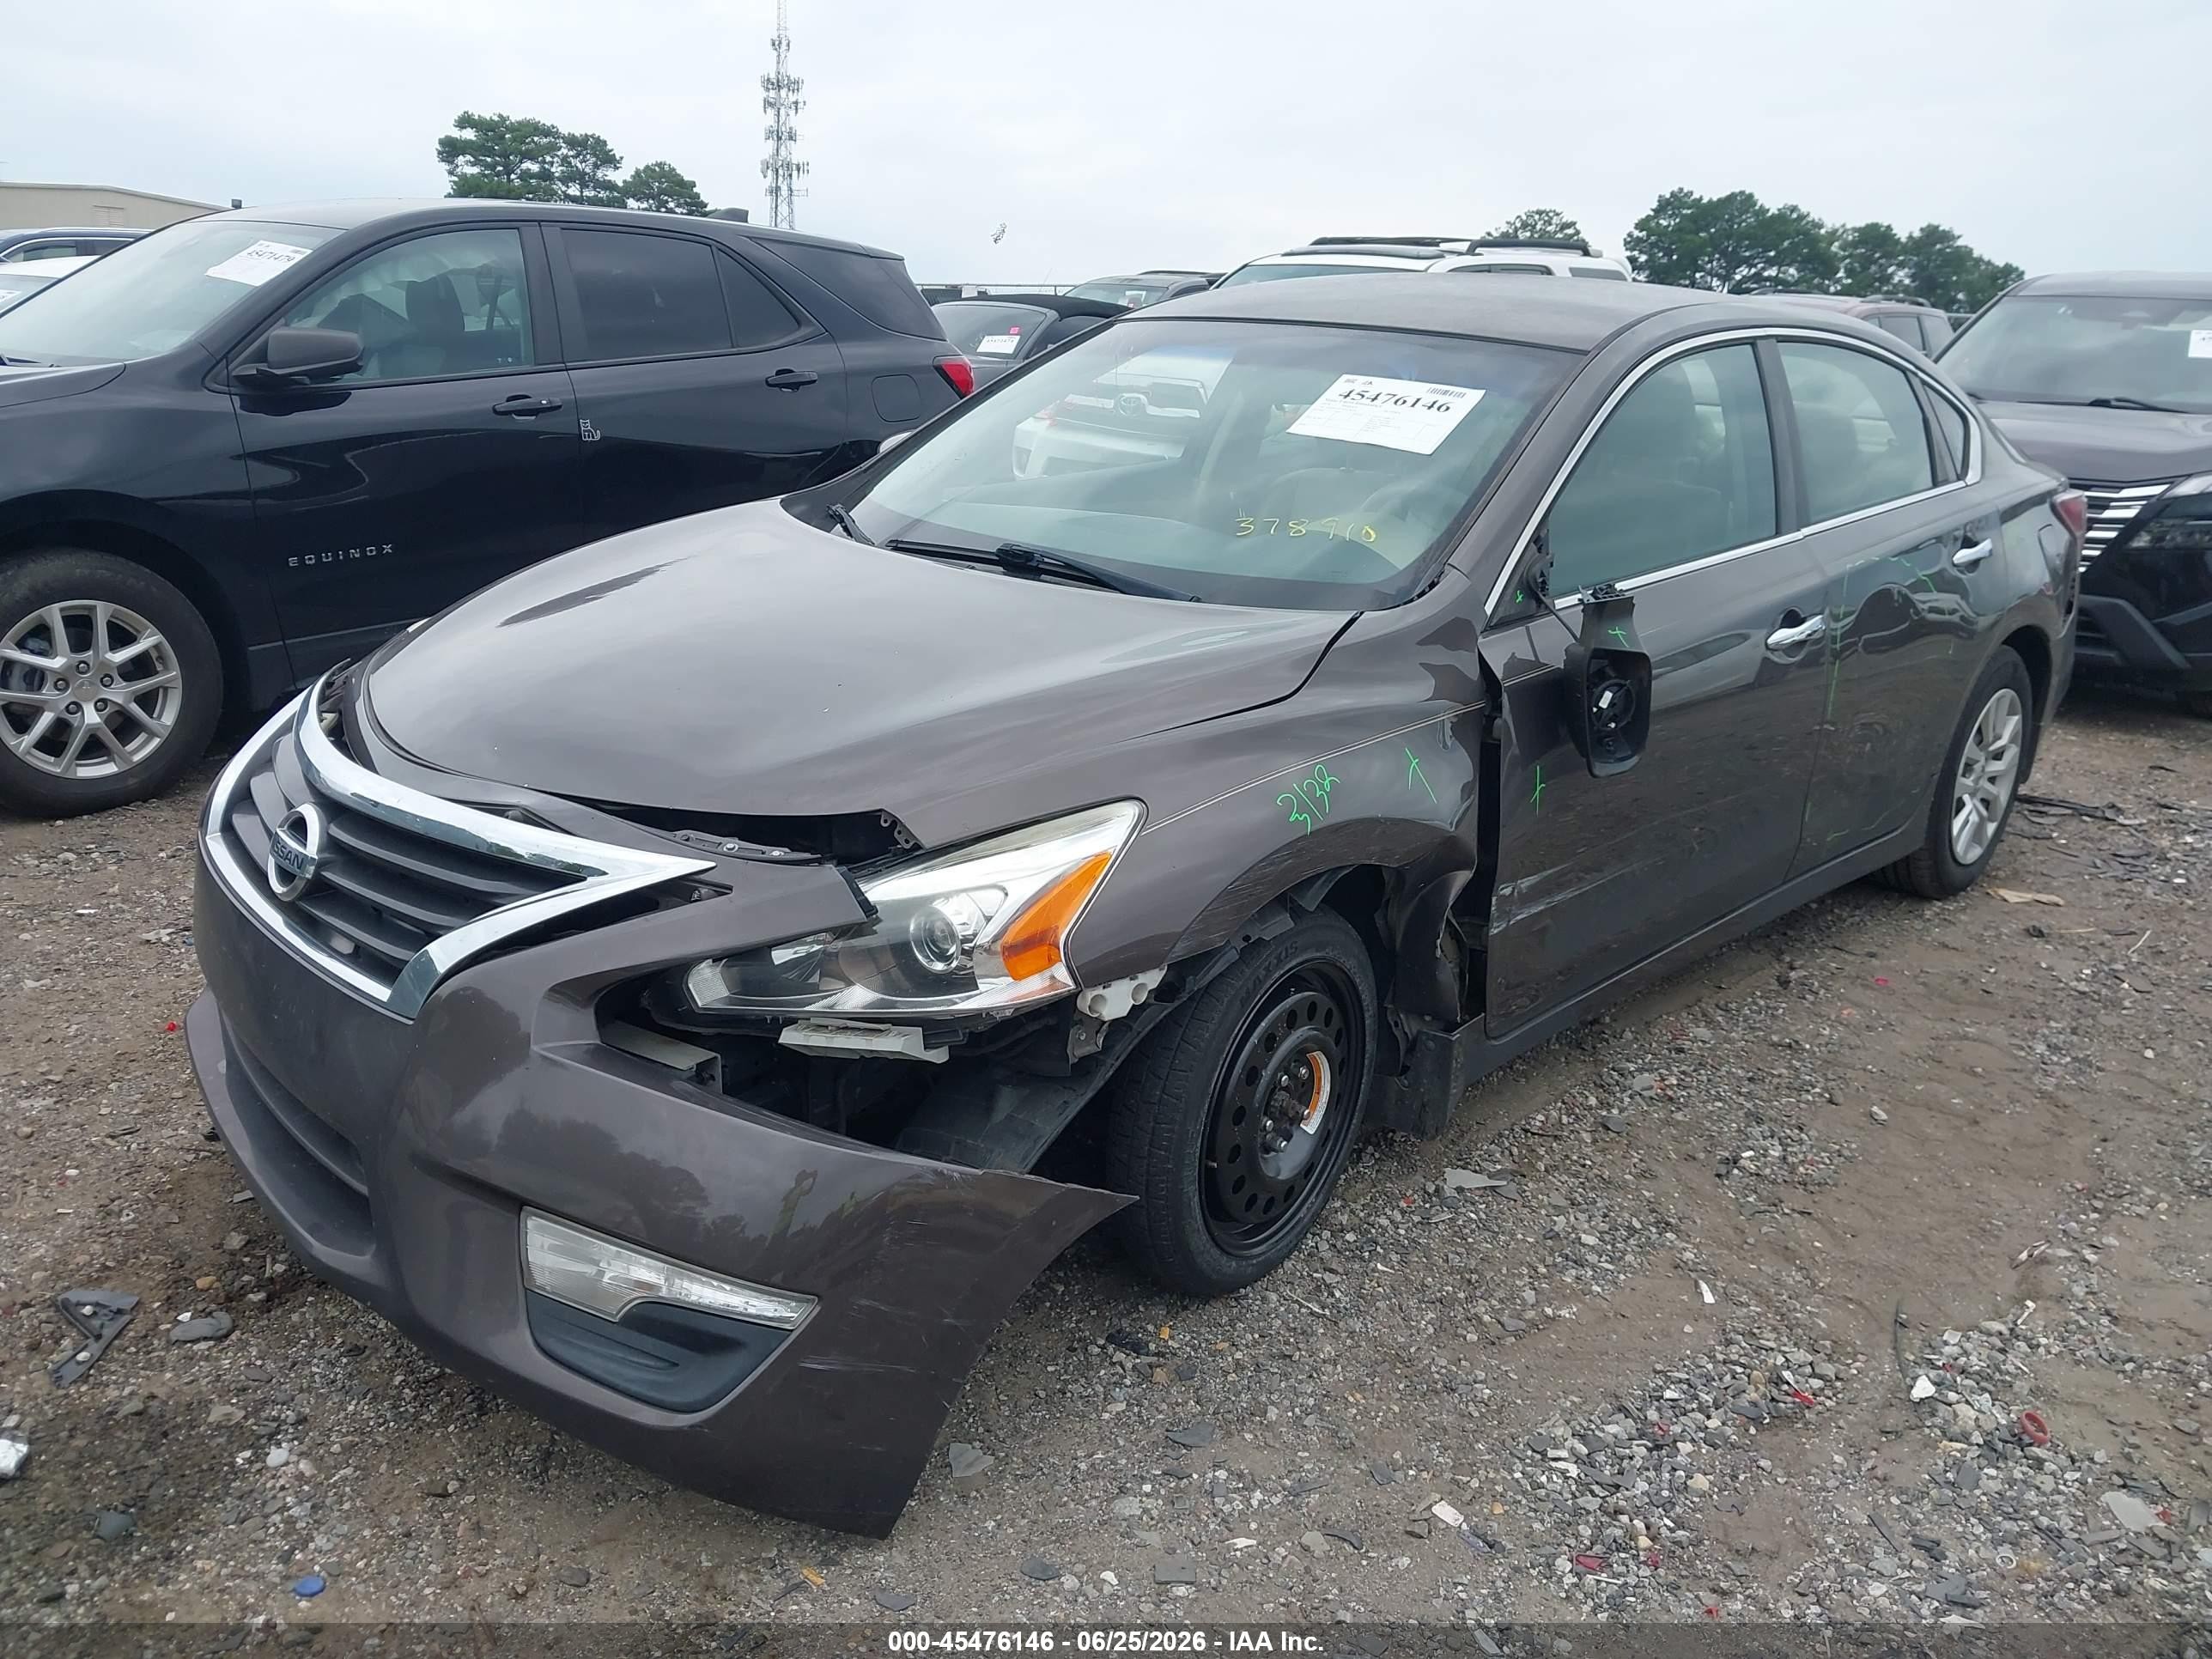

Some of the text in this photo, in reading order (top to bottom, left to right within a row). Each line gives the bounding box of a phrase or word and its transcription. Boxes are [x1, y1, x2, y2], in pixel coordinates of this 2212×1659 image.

[1338, 388, 1451, 413] 45476146
[288, 544, 392, 567] EQUINOX
[273, 835, 305, 870] SSAN
